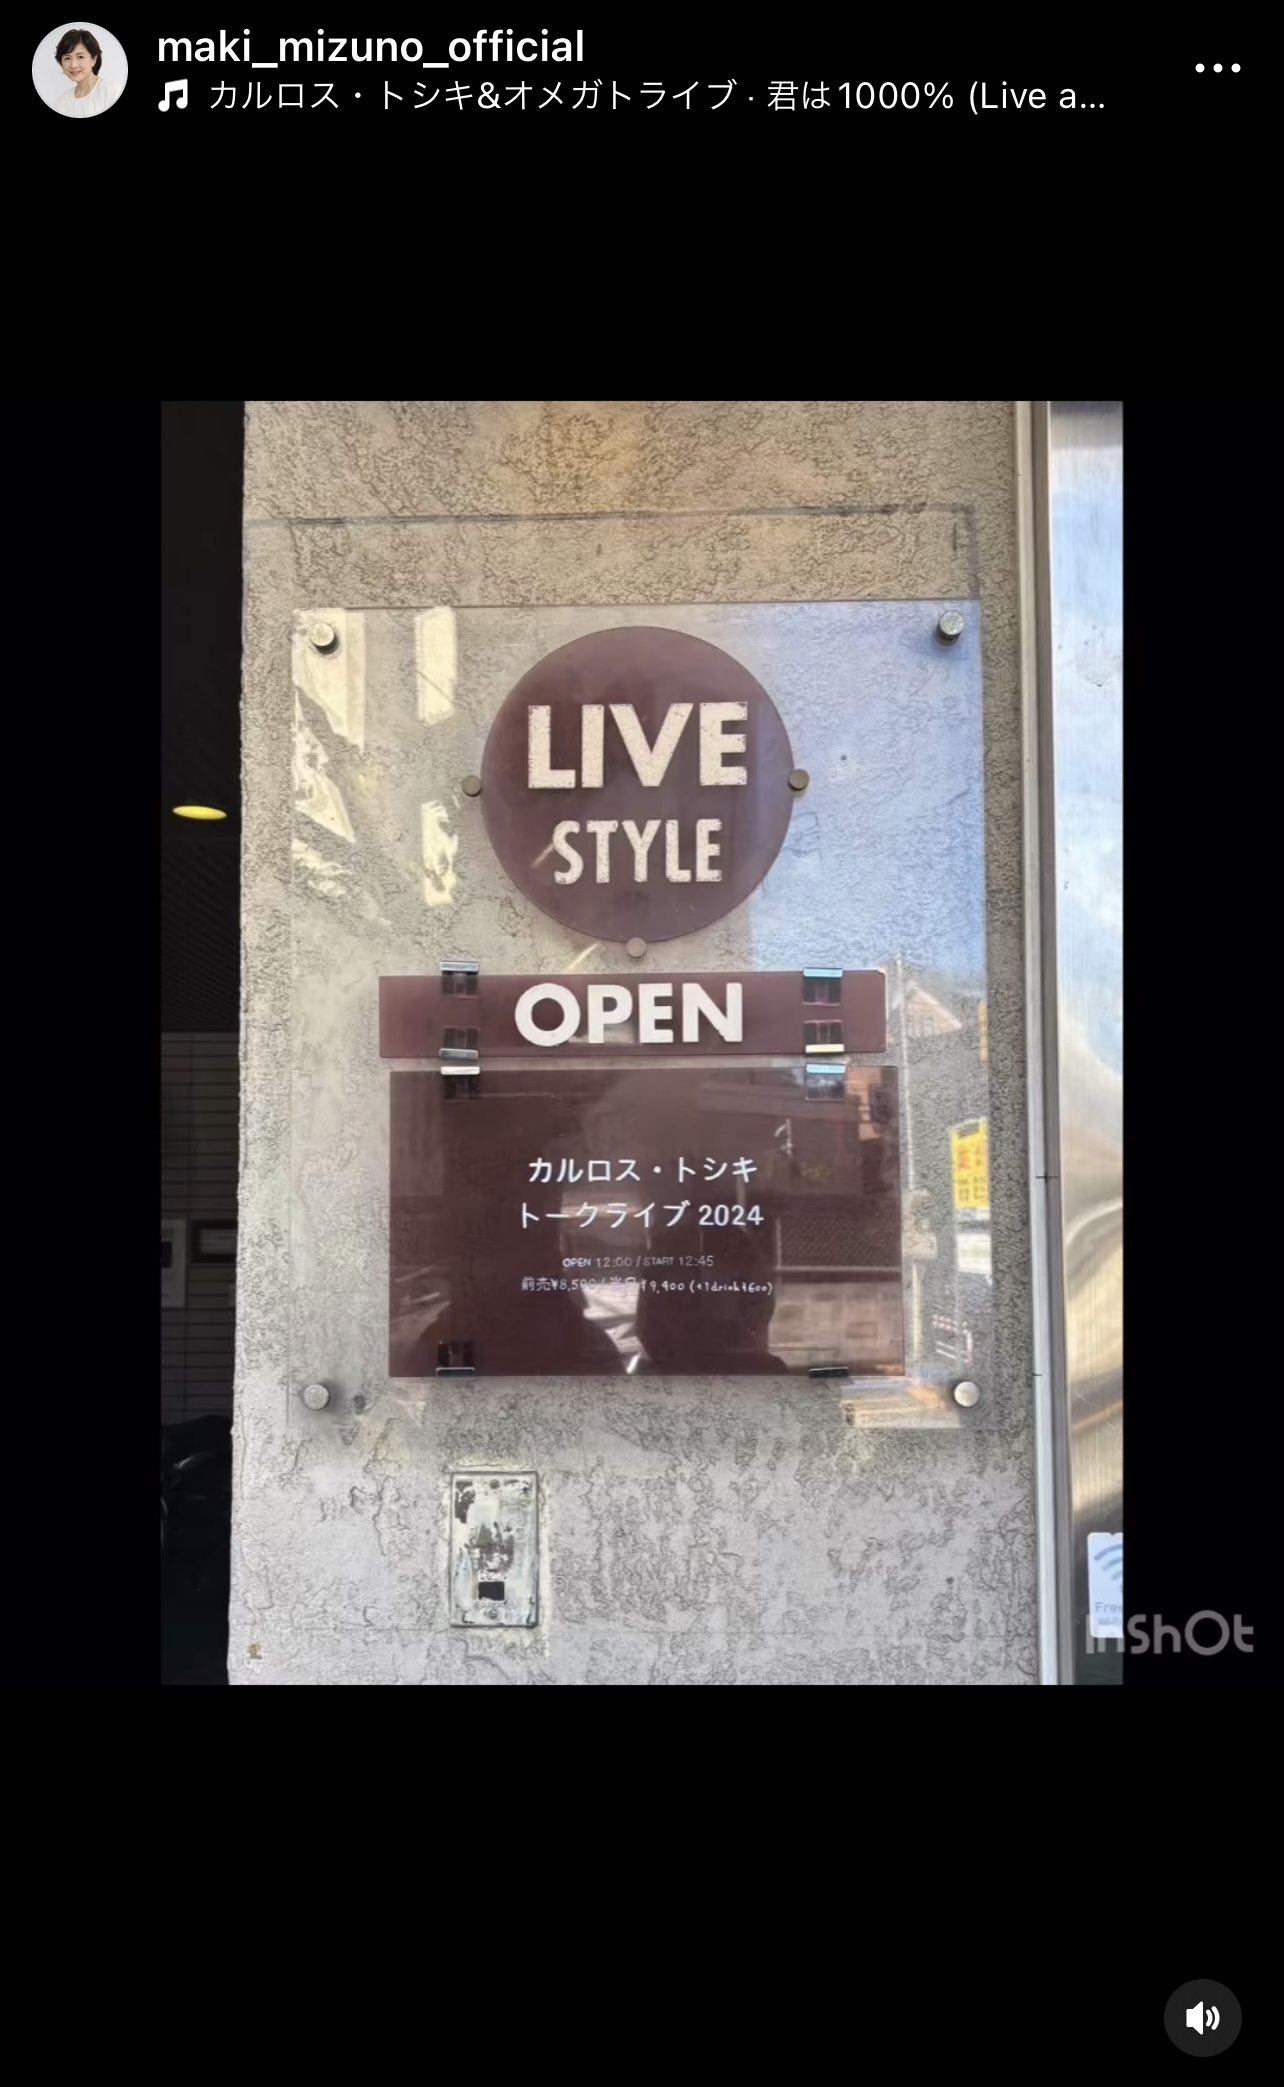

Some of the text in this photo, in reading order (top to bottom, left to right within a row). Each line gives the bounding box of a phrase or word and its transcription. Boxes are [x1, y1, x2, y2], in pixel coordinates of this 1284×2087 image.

[528, 702, 748, 789] LIVE
[552, 818, 723, 885] STYLE
[515, 982, 743, 1047] OPEN
[528, 1156, 758, 1183] カルロス・トシキ
[521, 1200, 764, 1229] トークライブ 2024
[562, 1257, 592, 1268] OPEN
[596, 1256, 633, 1268] 12:00
[643, 1256, 675, 1267] START
[679, 1255, 715, 1268] 12:45
